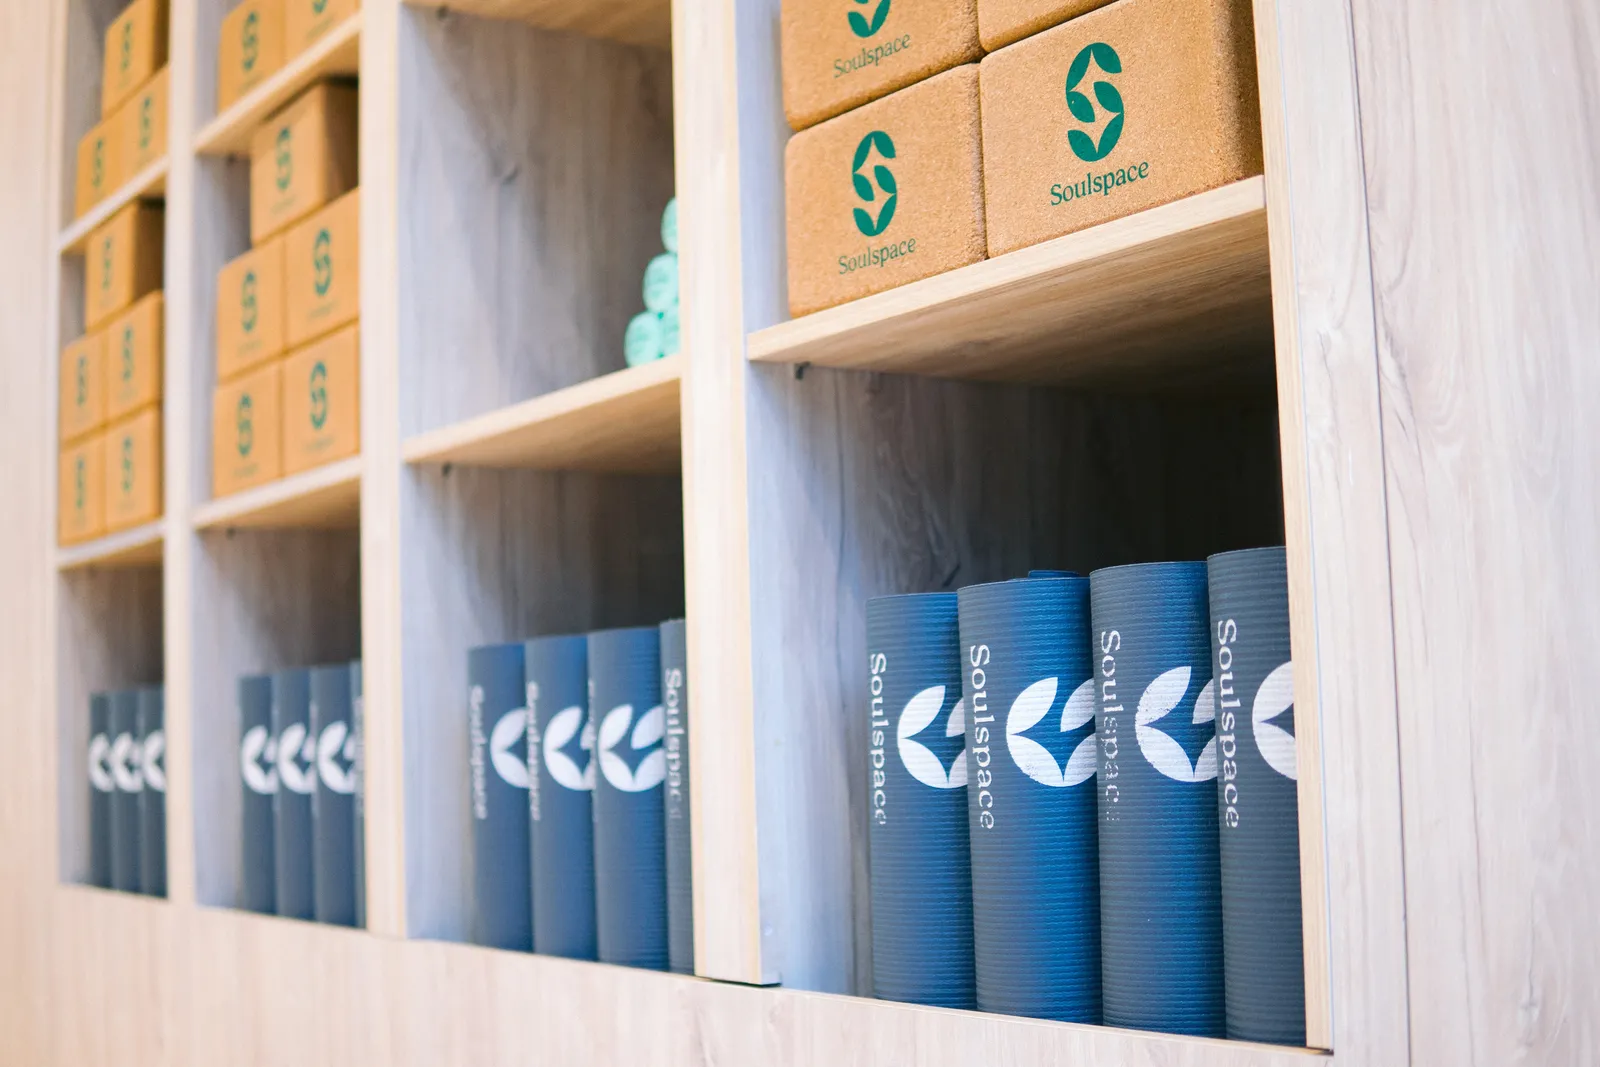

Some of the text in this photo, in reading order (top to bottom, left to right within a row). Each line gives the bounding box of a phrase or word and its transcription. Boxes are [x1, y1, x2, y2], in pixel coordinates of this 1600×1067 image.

[833, 34, 911, 79] Soulspace
[838, 237, 917, 275] Soulspace
[1050, 161, 1150, 206] Soulspace
[664, 667, 685, 820] Soulspac
[969, 643, 995, 830] Soulspace
[1101, 629, 1125, 822] Soulspac
[1217, 618, 1242, 829] Soulspace
